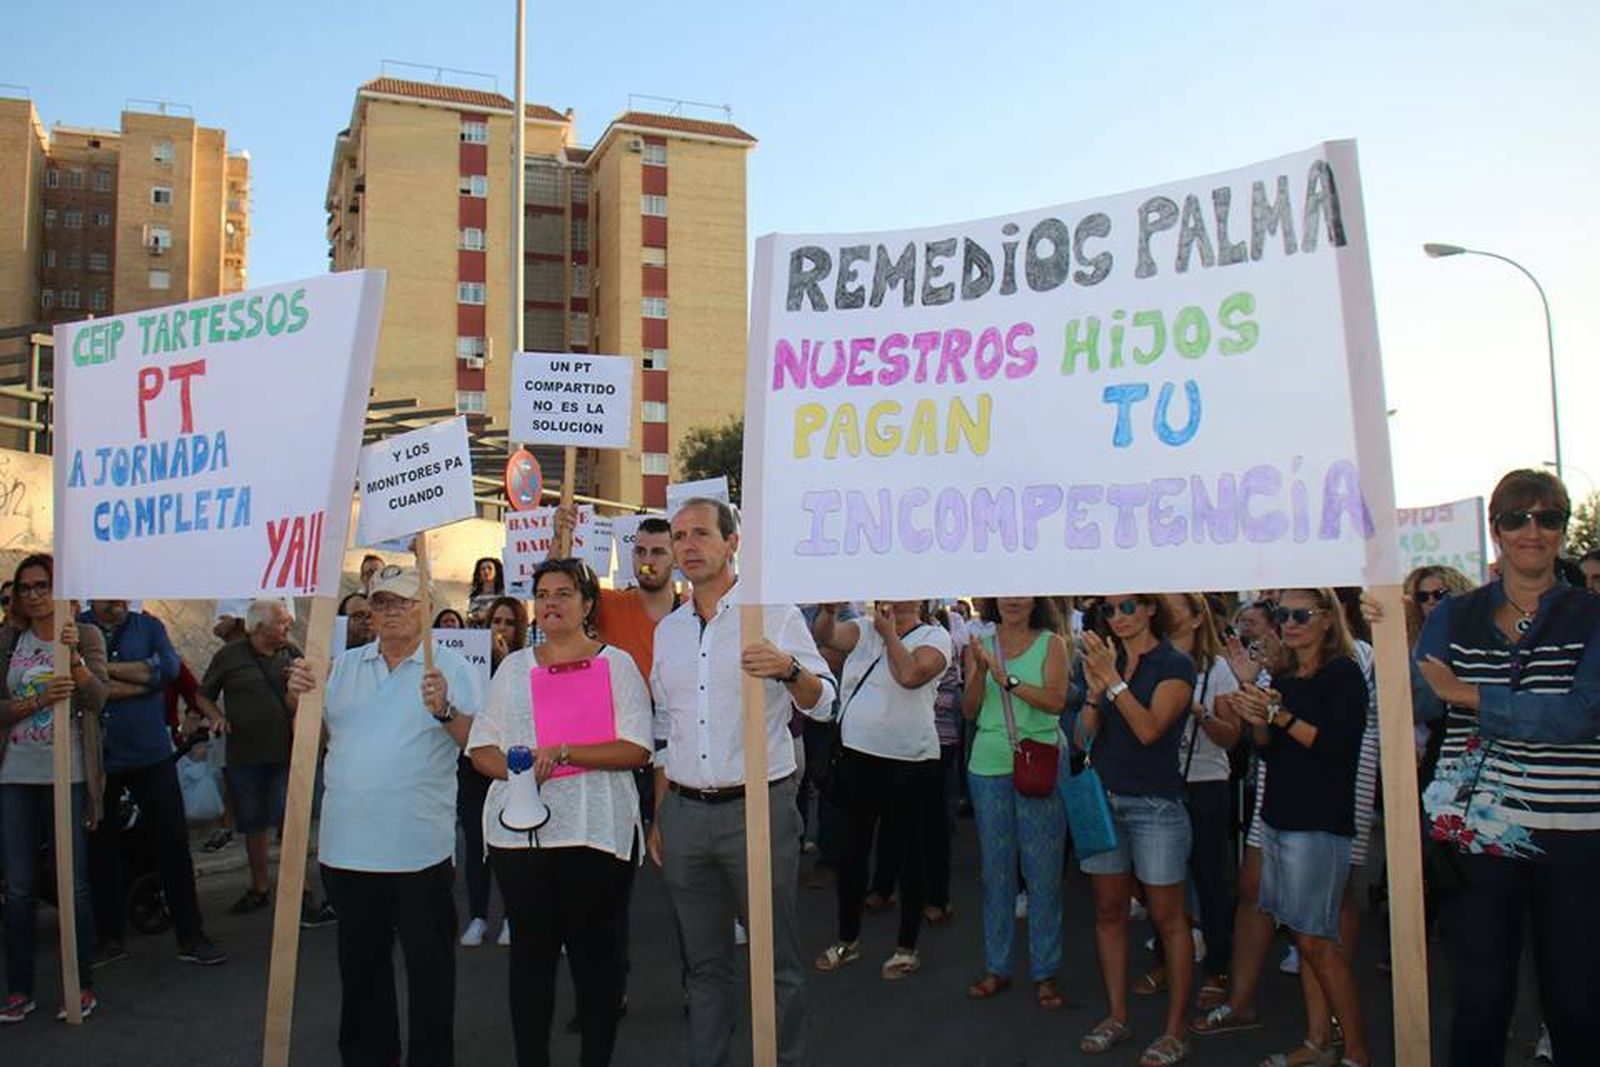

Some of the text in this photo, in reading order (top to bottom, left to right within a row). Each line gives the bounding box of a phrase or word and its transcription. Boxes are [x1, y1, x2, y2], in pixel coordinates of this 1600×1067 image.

[1135, 160, 1347, 279] PALMA
[138, 289, 309, 355] TARTESSOS
[550, 361, 592, 373] UN PT
[773, 322, 1038, 391] NUESTROS
[138, 359, 206, 439] PT
[525, 380, 616, 395] COMPARTIDO
[561, 402, 579, 413] ES
[587, 403, 605, 415] LA
[532, 420, 604, 434] SOLUCIÓN
[793, 380, 1201, 459] PAGAN TU
[67, 430, 229, 488] A JORNADA
[367, 456, 463, 494] MONITORES PA
[393, 442, 430, 463] Y LOS
[93, 486, 252, 541] COMPLETA
[388, 485, 444, 510] CUANDO
[261, 511, 325, 594] YA!!
[445, 639, 465, 648] LOS
